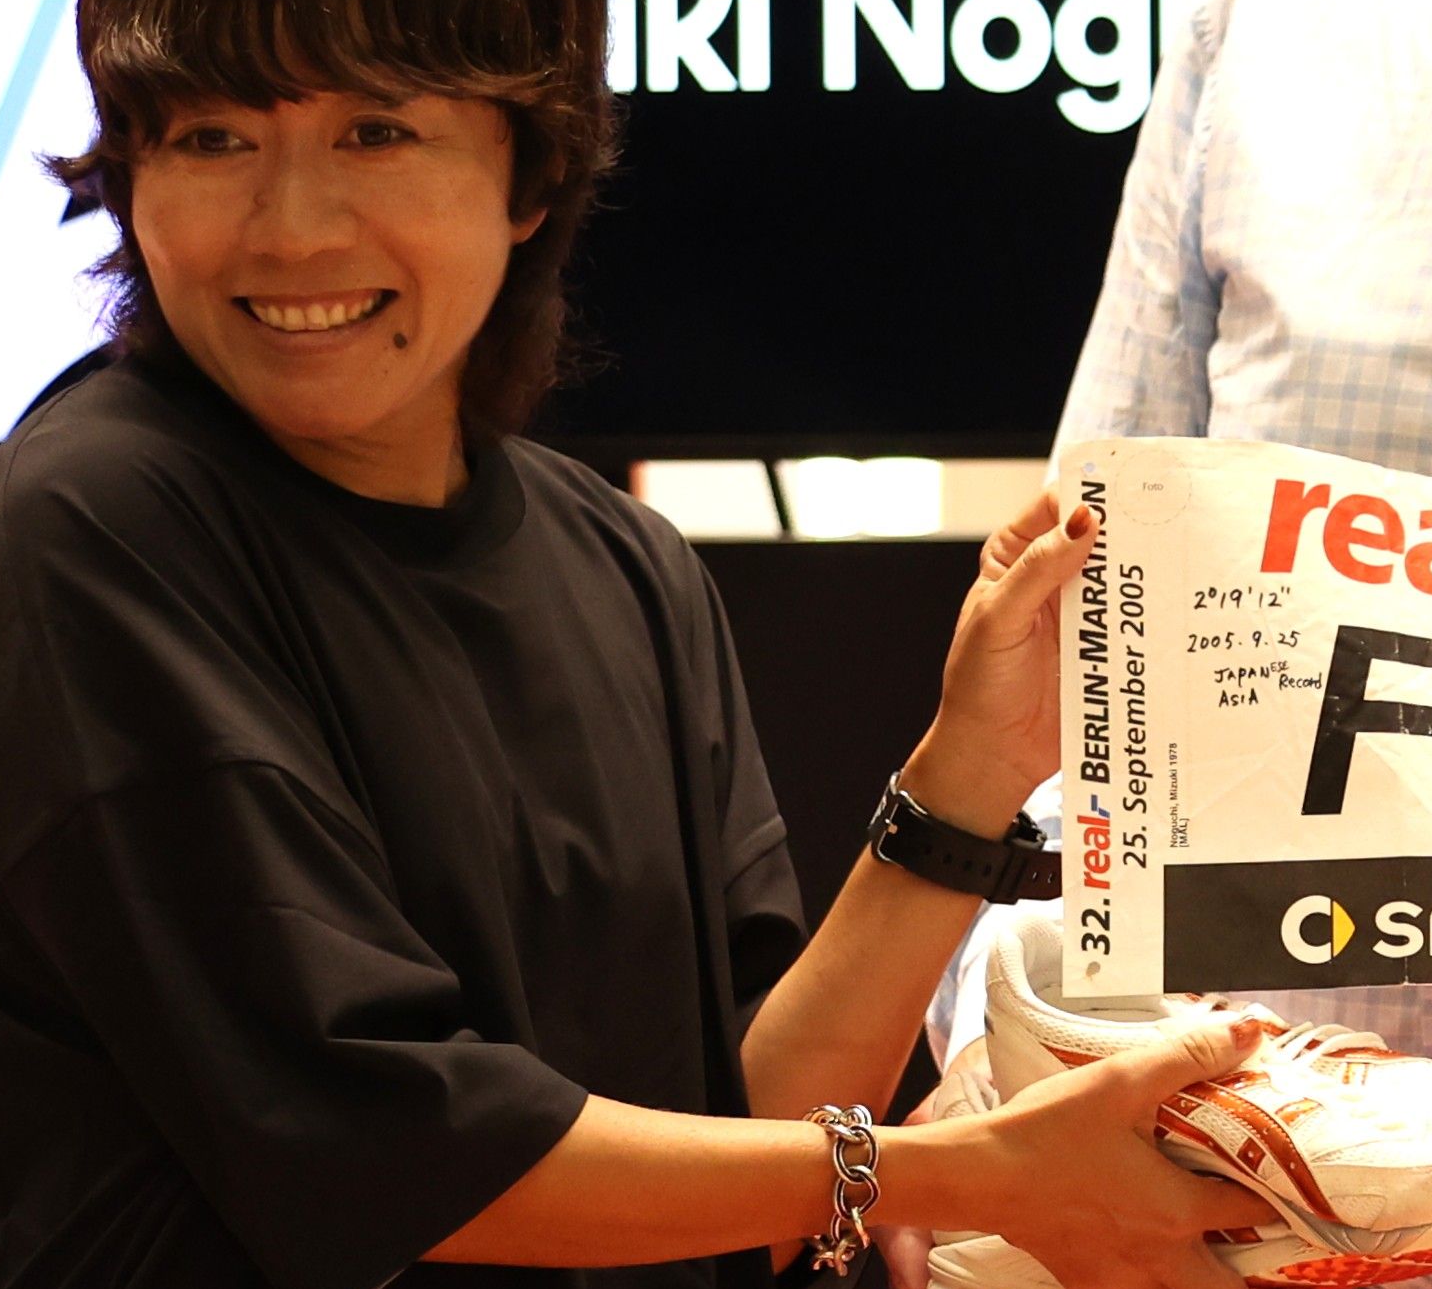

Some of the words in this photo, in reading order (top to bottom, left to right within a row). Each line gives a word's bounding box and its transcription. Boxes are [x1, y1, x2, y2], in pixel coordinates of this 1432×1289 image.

[1119, 563, 1145, 638] 2005
[1279, 671, 1322, 691] Record
[1119, 644, 1153, 814] September
[1168, 742, 1178, 766] 1978
[1169, 769, 1178, 801] Mizuki
[1122, 825, 1147, 869] 25.
[1080, 896, 1111, 956] 32.
